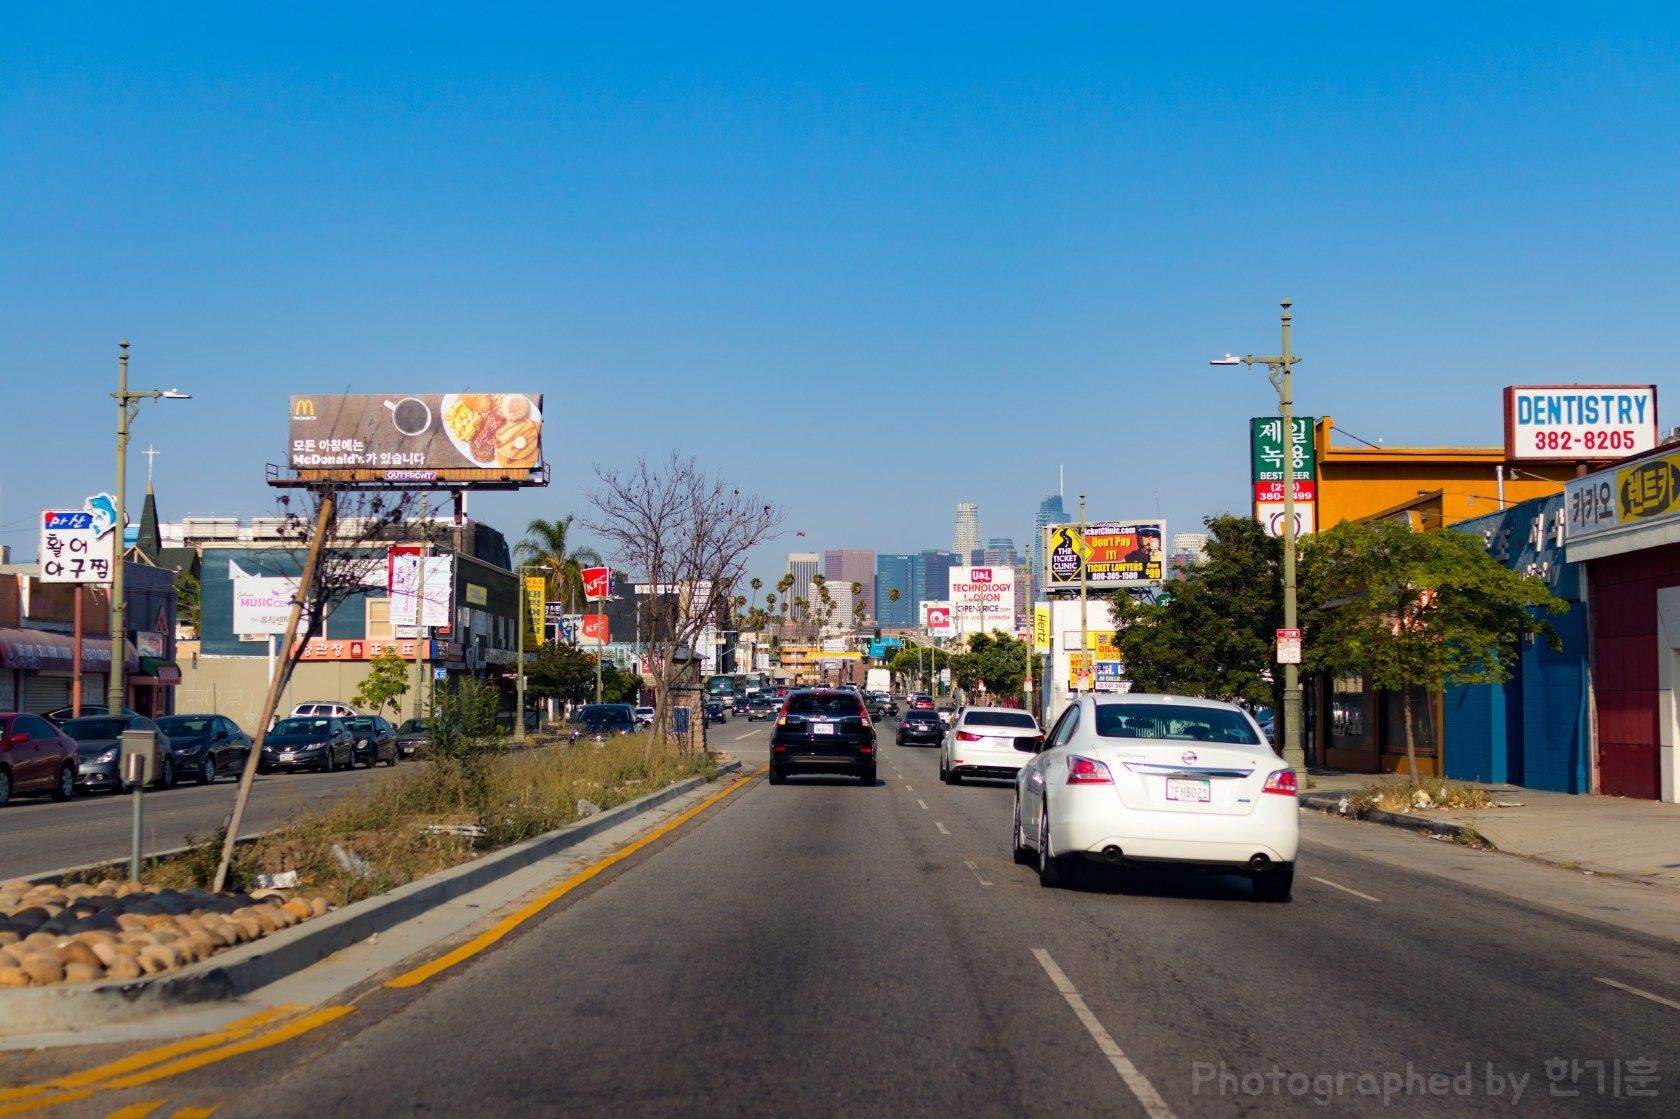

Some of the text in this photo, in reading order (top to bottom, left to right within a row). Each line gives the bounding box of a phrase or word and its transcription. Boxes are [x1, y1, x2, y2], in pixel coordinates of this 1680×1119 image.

[1517, 395, 1648, 426] DENTISTRY
[1258, 420, 1308, 444] 제일
[293, 439, 365, 451] 모든 아침에는
[1534, 430, 1635, 450] 382-8205
[380, 452, 426, 465] 있습니다
[1260, 445, 1310, 469] 녹용
[386, 471, 434, 480] OUTFRONT
[1260, 471, 1310, 480] BEST EER
[1572, 463, 1675, 528] 카카오 렌트카
[48, 514, 86, 528] 마산
[1084, 527, 1136, 536] icketClinic.com
[46, 533, 88, 558] 활어
[1091, 537, 1131, 548] Don't Pay
[1058, 547, 1072, 555] THE
[1052, 555, 1078, 563] TICKET
[44, 558, 109, 579] 아구찜
[1052, 562, 1078, 570] CLINIC
[1086, 564, 1111, 573] TICKET
[1111, 562, 1143, 572] LAWYERS
[972, 571, 991, 580] U&L
[1145, 568, 1160, 579] $99
[585, 574, 607, 593] KFC
[953, 583, 1011, 592] TECHNOLOGY
[239, 598, 273, 608] MUSIC
[585, 621, 606, 634] KFC
[1037, 614, 1047, 644] Hertz
